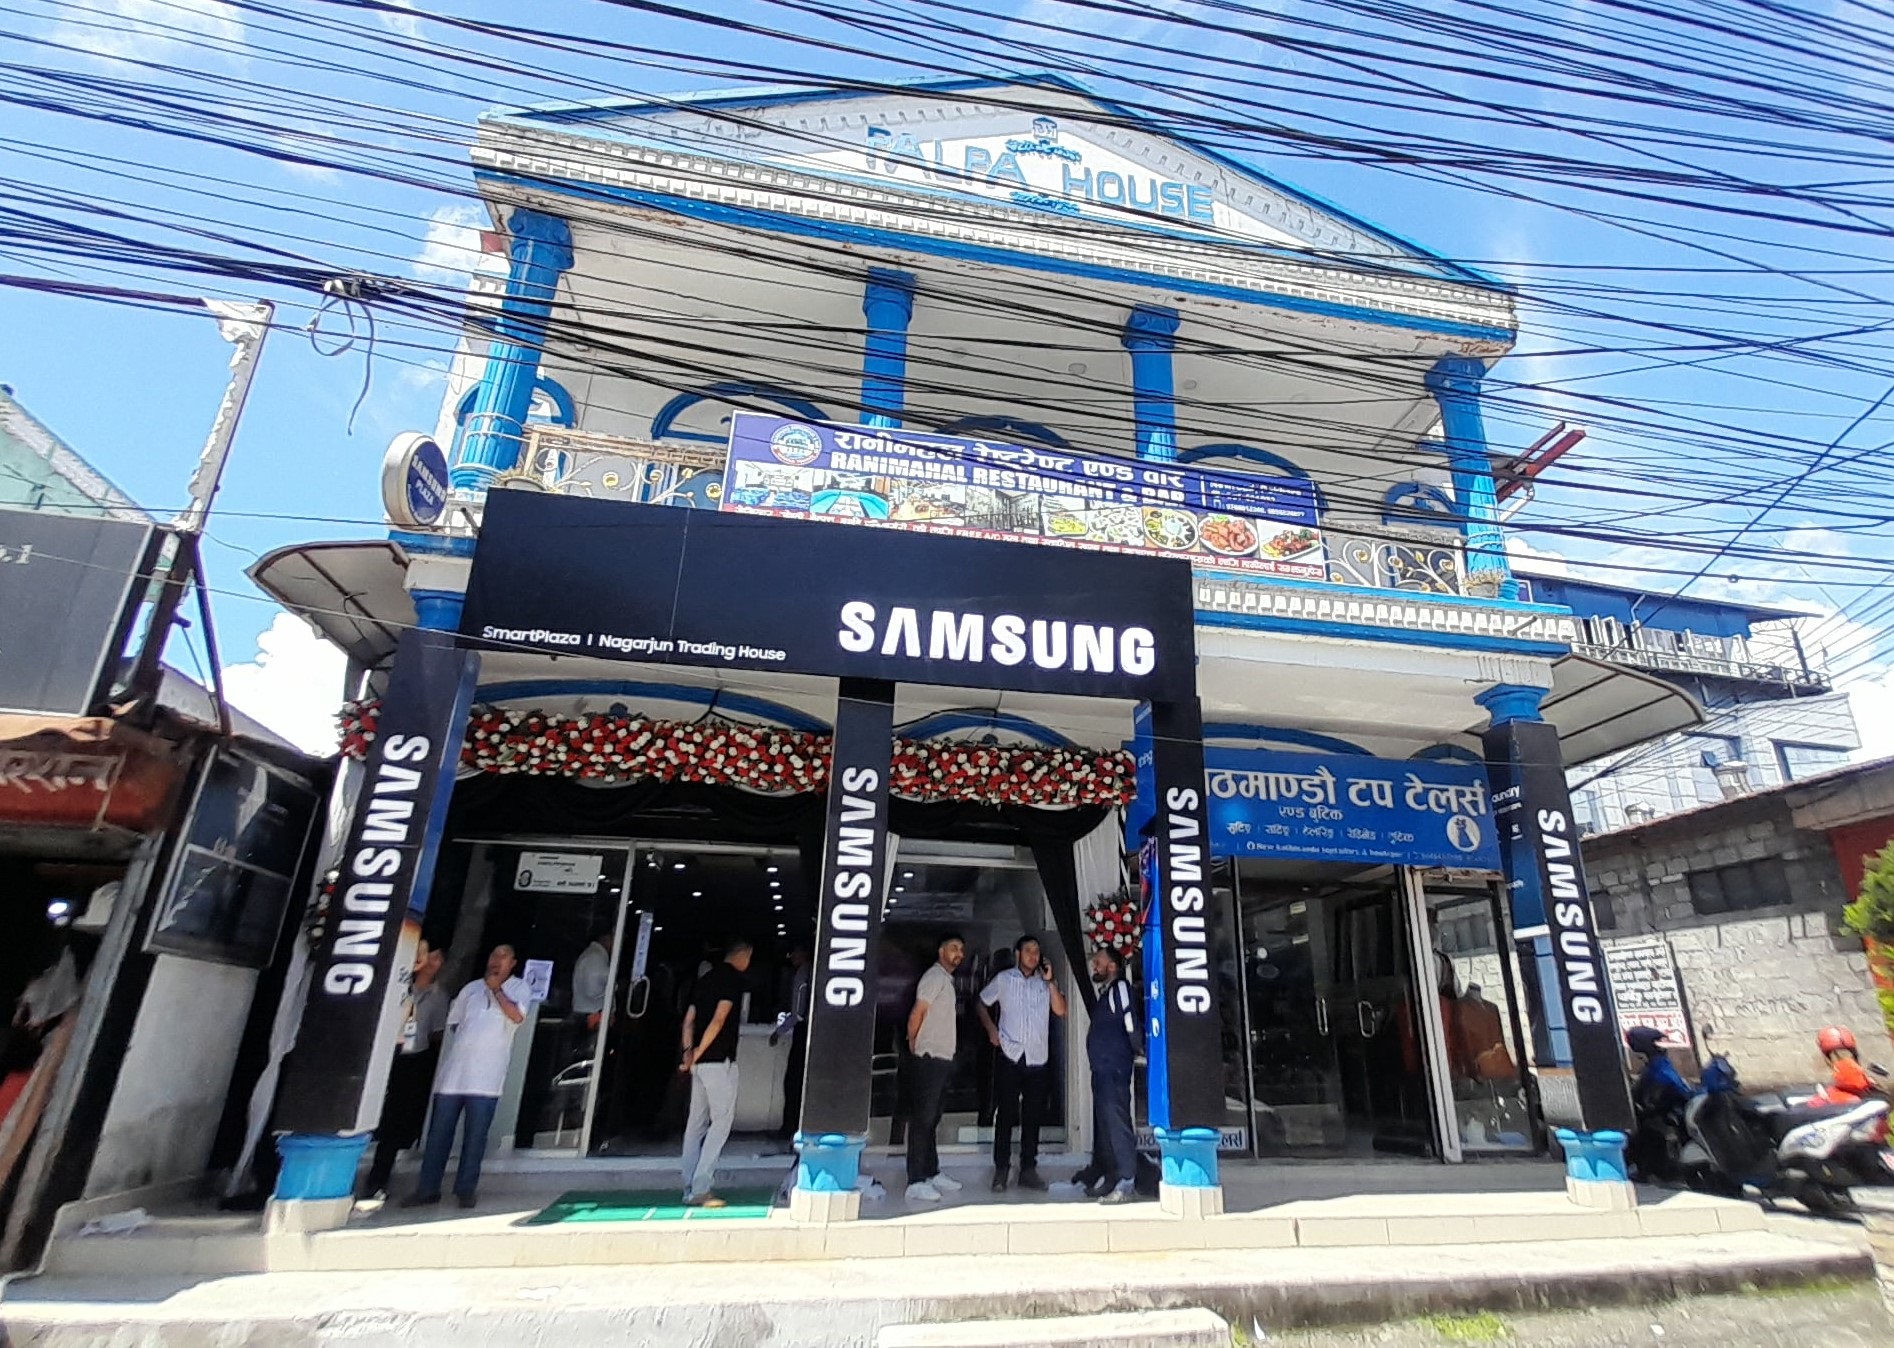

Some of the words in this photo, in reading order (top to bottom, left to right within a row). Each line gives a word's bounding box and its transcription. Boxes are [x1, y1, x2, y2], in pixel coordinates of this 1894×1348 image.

[866, 124, 1027, 190] PALPA
[1062, 163, 1215, 223] HOUSE
[829, 451, 968, 483] RANIMAHAL
[972, 466, 1118, 501] RESTAURANT
[1140, 486, 1186, 508] BAR
[482, 625, 581, 645] SmartPlaza
[599, 634, 674, 654] Nagarjun
[677, 639, 736, 661] Trading
[738, 645, 787, 661] House
[838, 601, 1155, 676] SAMSUNG
[1346, 778, 1394, 808] टप
[1402, 772, 1487, 817] टेलर्स
[323, 734, 431, 995] SAMSUNG
[825, 767, 879, 1007] SAMSUNG
[1166, 787, 1211, 1013] SAMSUNG
[1537, 809, 1603, 1024] SAMSUNG
